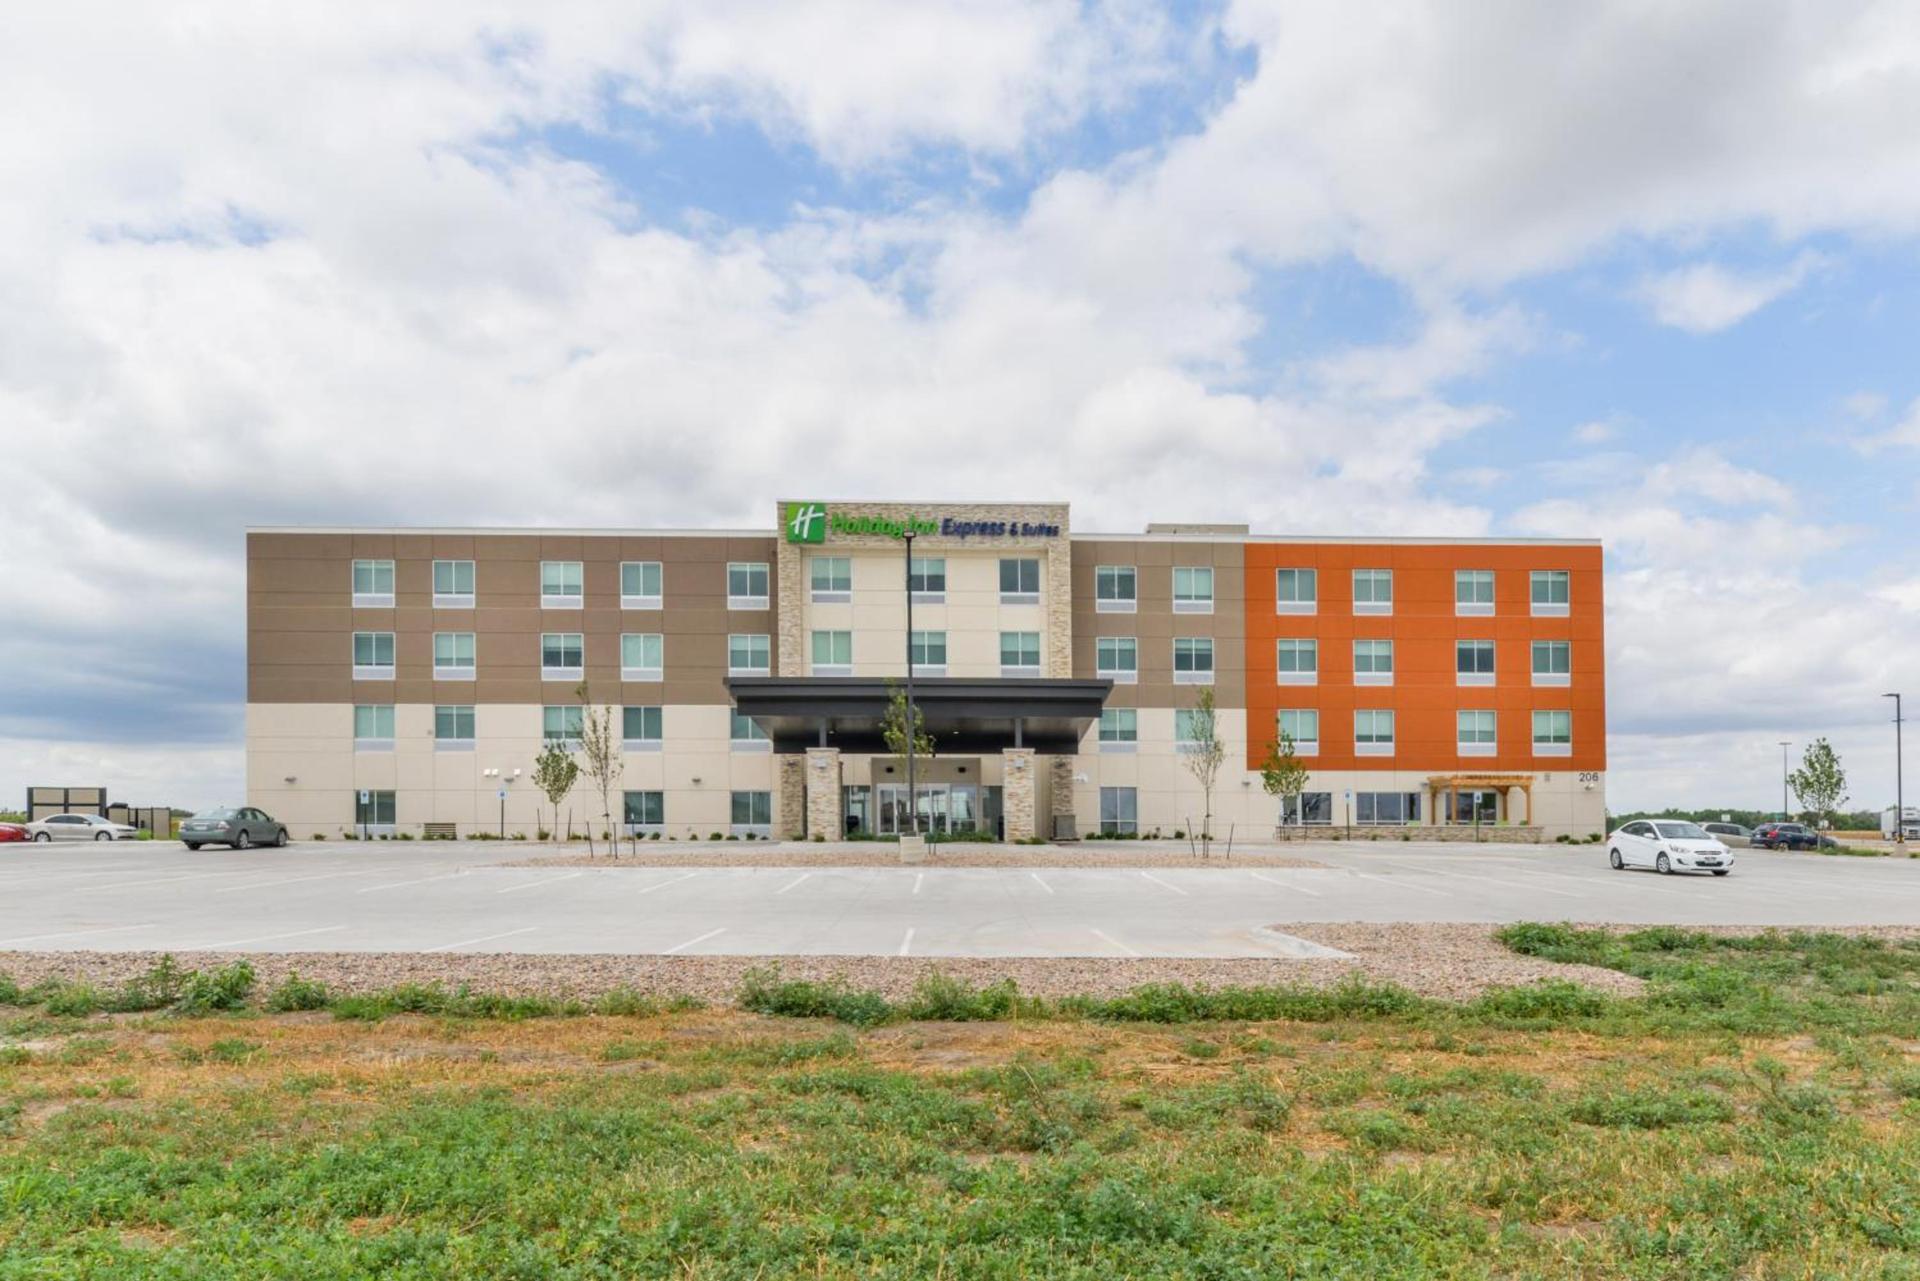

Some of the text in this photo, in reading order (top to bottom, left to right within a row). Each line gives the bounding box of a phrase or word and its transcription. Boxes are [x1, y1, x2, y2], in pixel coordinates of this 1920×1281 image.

[831, 512, 1059, 539] Holiday Inn Express & Suites
[1579, 772, 1599, 782] 206
